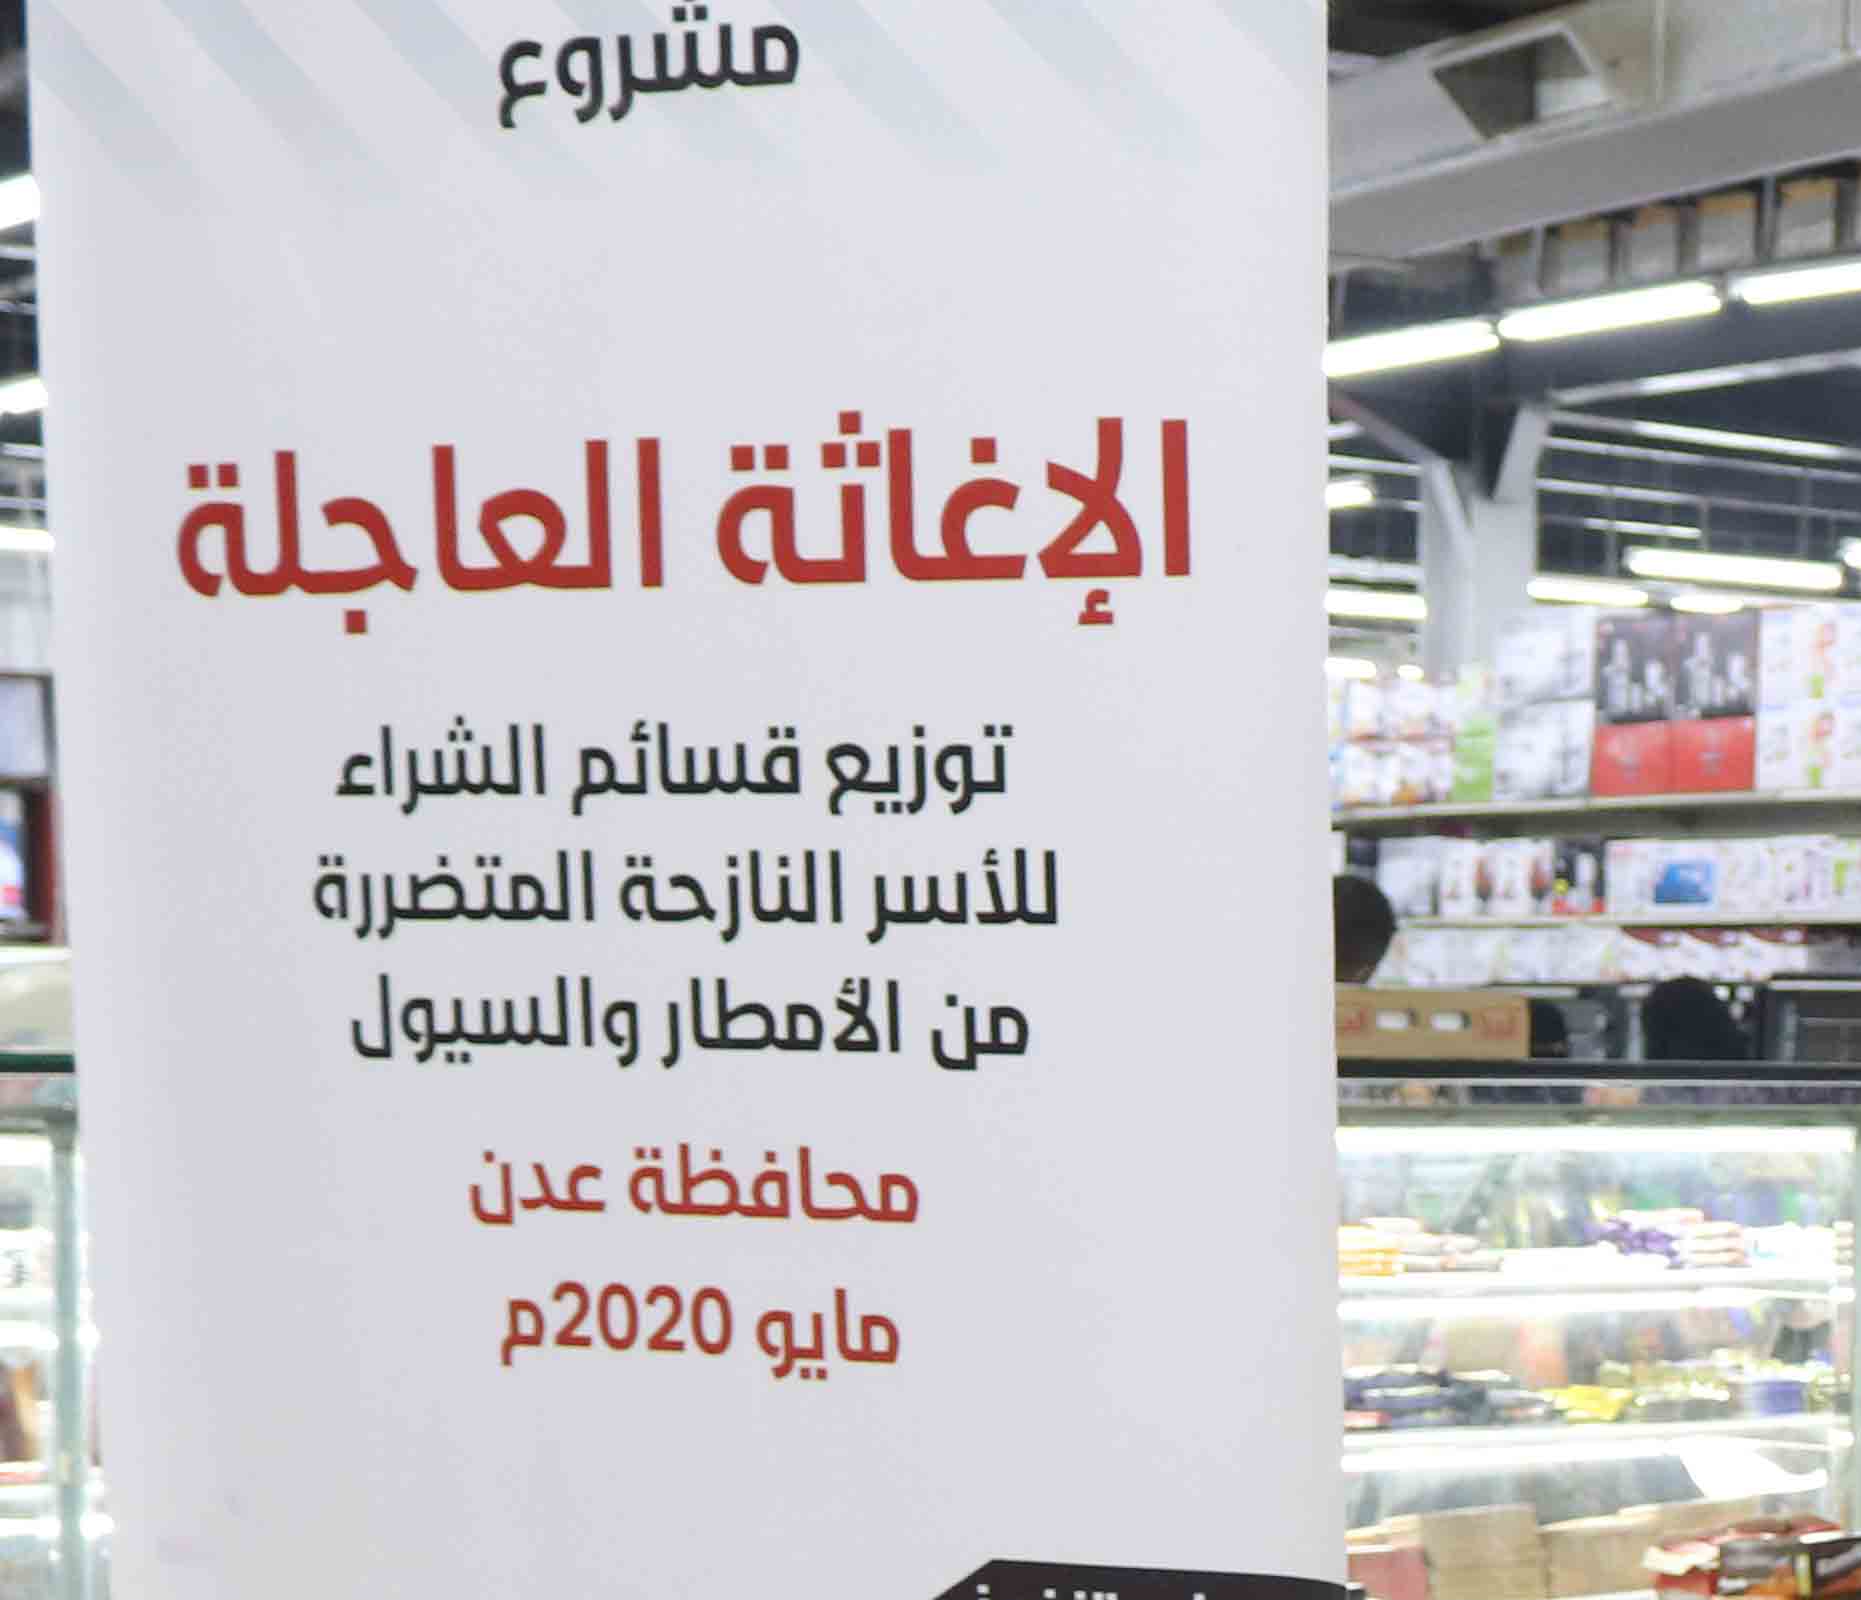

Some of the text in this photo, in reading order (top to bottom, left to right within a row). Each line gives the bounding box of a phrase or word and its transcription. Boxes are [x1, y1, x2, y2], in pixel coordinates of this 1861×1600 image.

[500, 6, 799, 128] مشروع
[180, 411, 1188, 632] الإغاثة العاجلة
[336, 716, 1012, 816] توزيع قسائم الشراء
[314, 848, 1057, 944] للأسر النازحة المتضررة
[352, 974, 1028, 1071] من الأمطار والسيول
[470, 1146, 918, 1223] محافظة عدن
[503, 1281, 897, 1376] مايو 2020م
